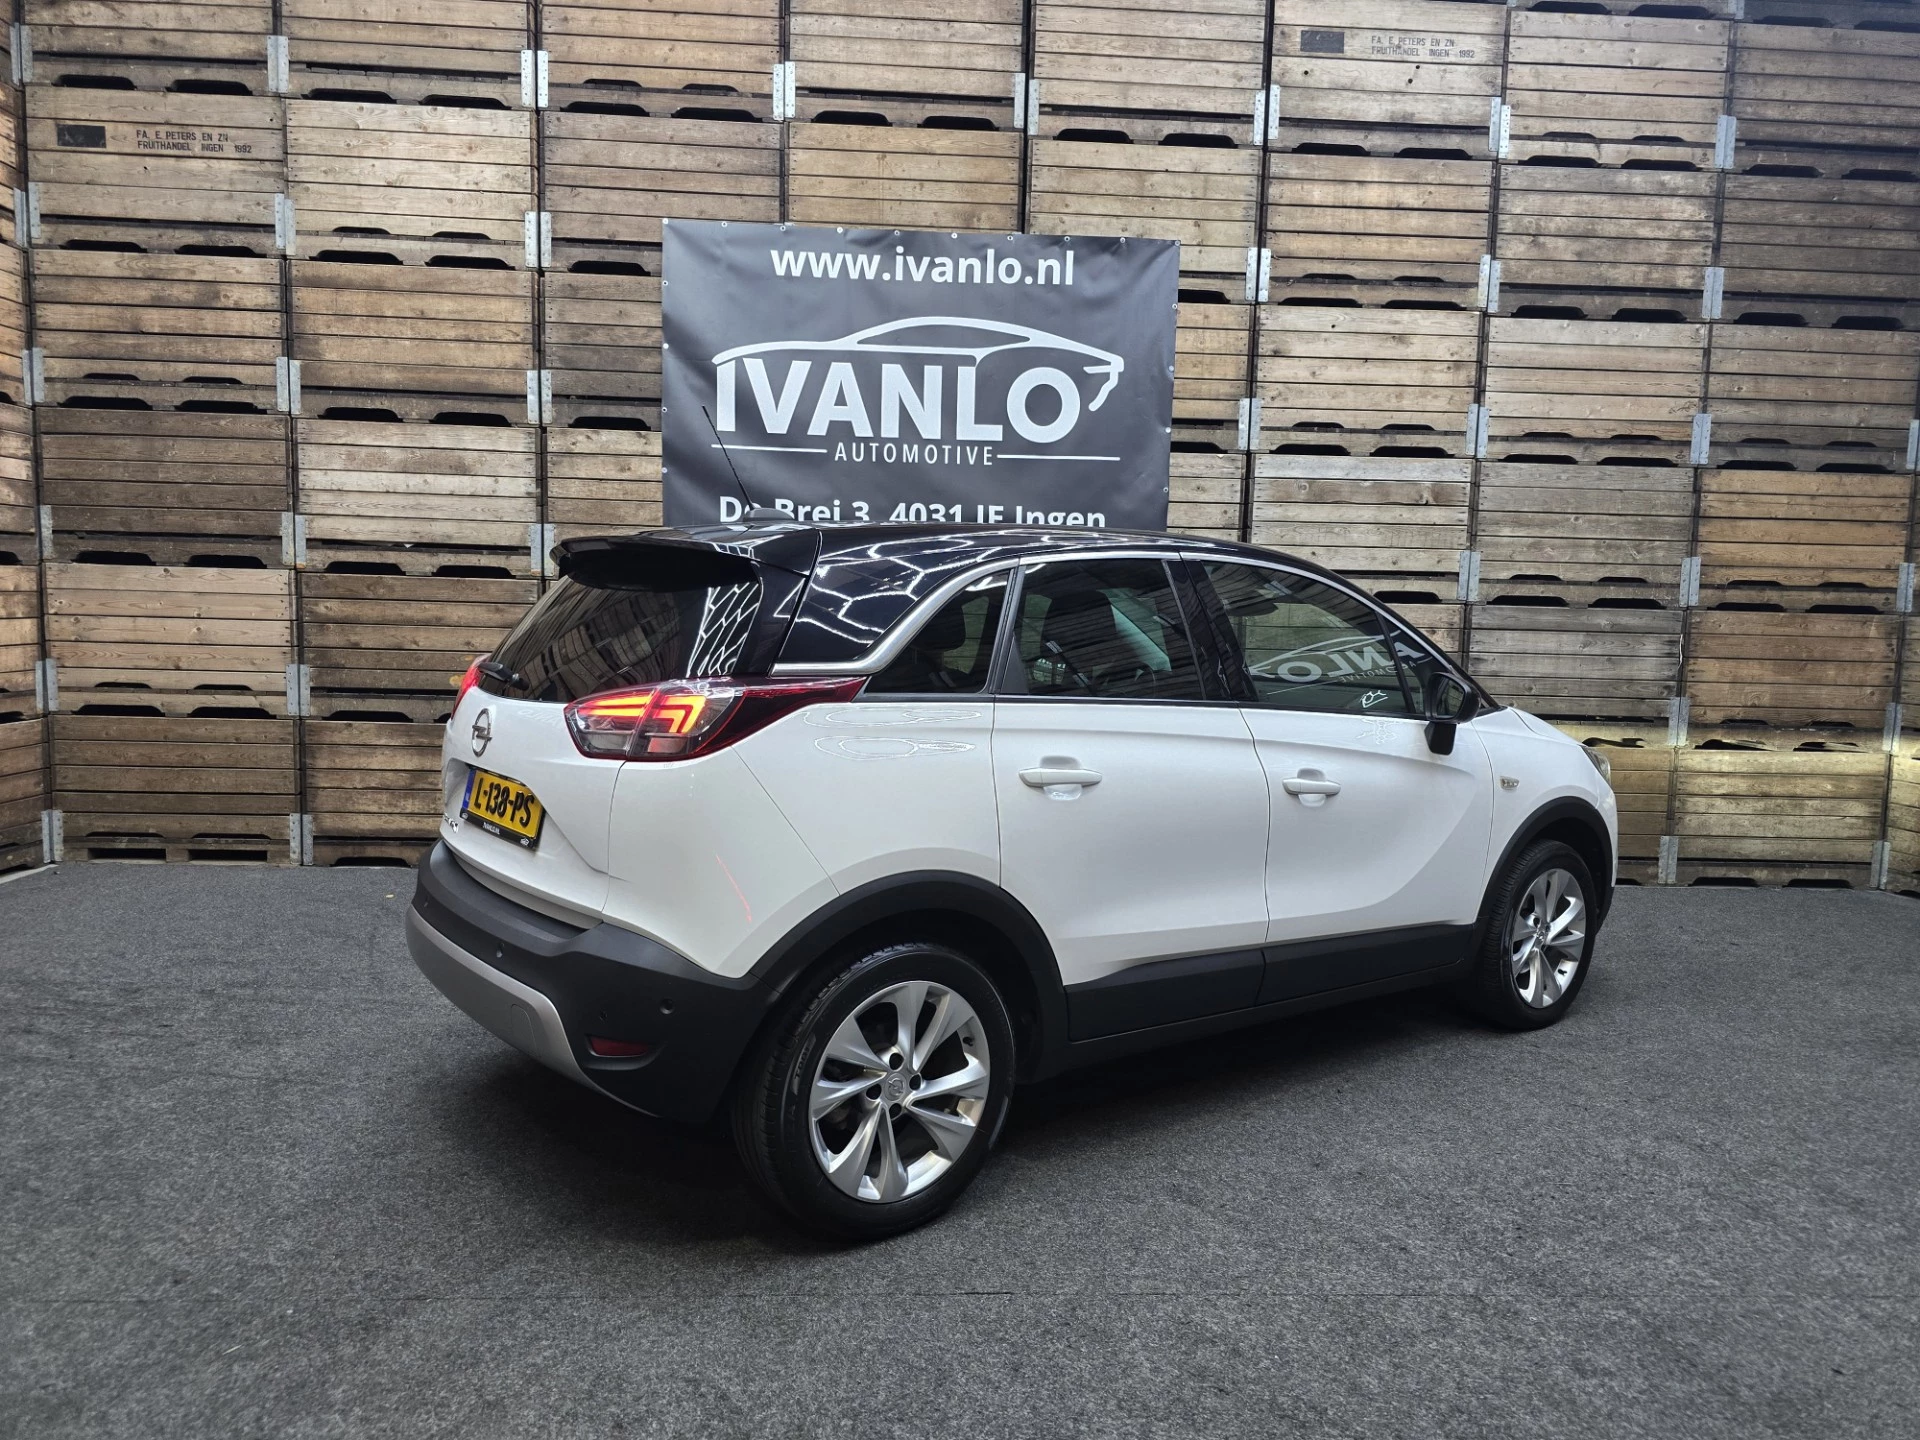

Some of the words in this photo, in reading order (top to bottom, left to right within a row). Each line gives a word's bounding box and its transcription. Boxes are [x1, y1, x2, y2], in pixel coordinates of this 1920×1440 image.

[1371, 45, 1421, 56] FRUITHANDEL
[1428, 48, 1450, 58] INGEN
[1458, 50, 1475, 59] 1992
[1398, 37, 1426, 46] PETERS
[1430, 38, 1441, 47] EN
[137, 140, 192, 151] FRUITHANDEL
[200, 143, 224, 152] INGEN
[234, 144, 252, 154] 1992
[165, 131, 197, 141] PETERS
[201, 132, 213, 142] EN
[770, 246, 1074, 285] www.ivanlo.nl
[717, 357, 1081, 444] IVANLO
[834, 442, 993, 466] AUTOMOTIVE
[719, 496, 762, 522] D
[474, 777, 535, 829] L-138-PS
